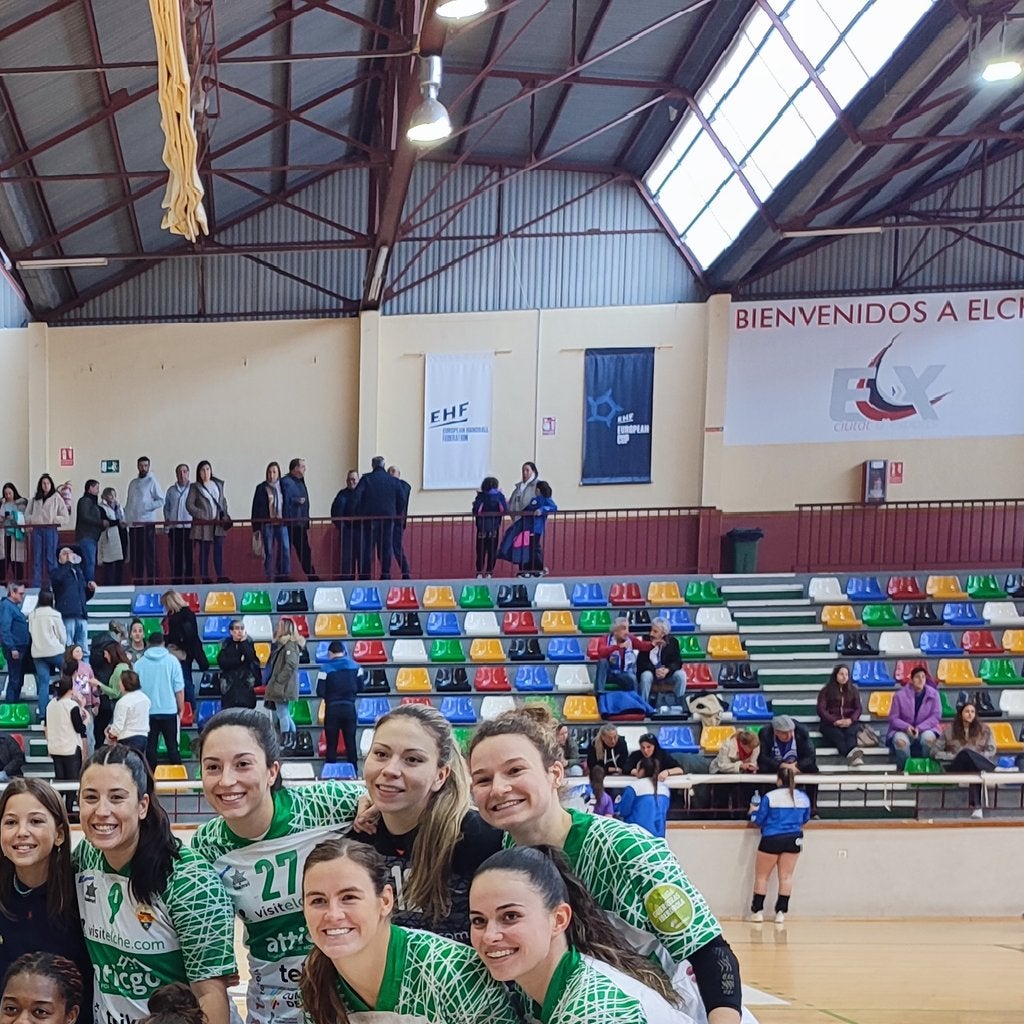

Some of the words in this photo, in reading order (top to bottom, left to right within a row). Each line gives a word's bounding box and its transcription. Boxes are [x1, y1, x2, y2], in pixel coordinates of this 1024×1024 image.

[735, 301, 927, 329] BIENVENIDOS
[937, 300, 958, 322] A
[430, 402, 470, 424] EHF
[255, 850, 299, 902] 27
[107, 882, 124, 925] 9
[88, 925, 165, 950] visitelche.com
[279, 964, 305, 983] te
